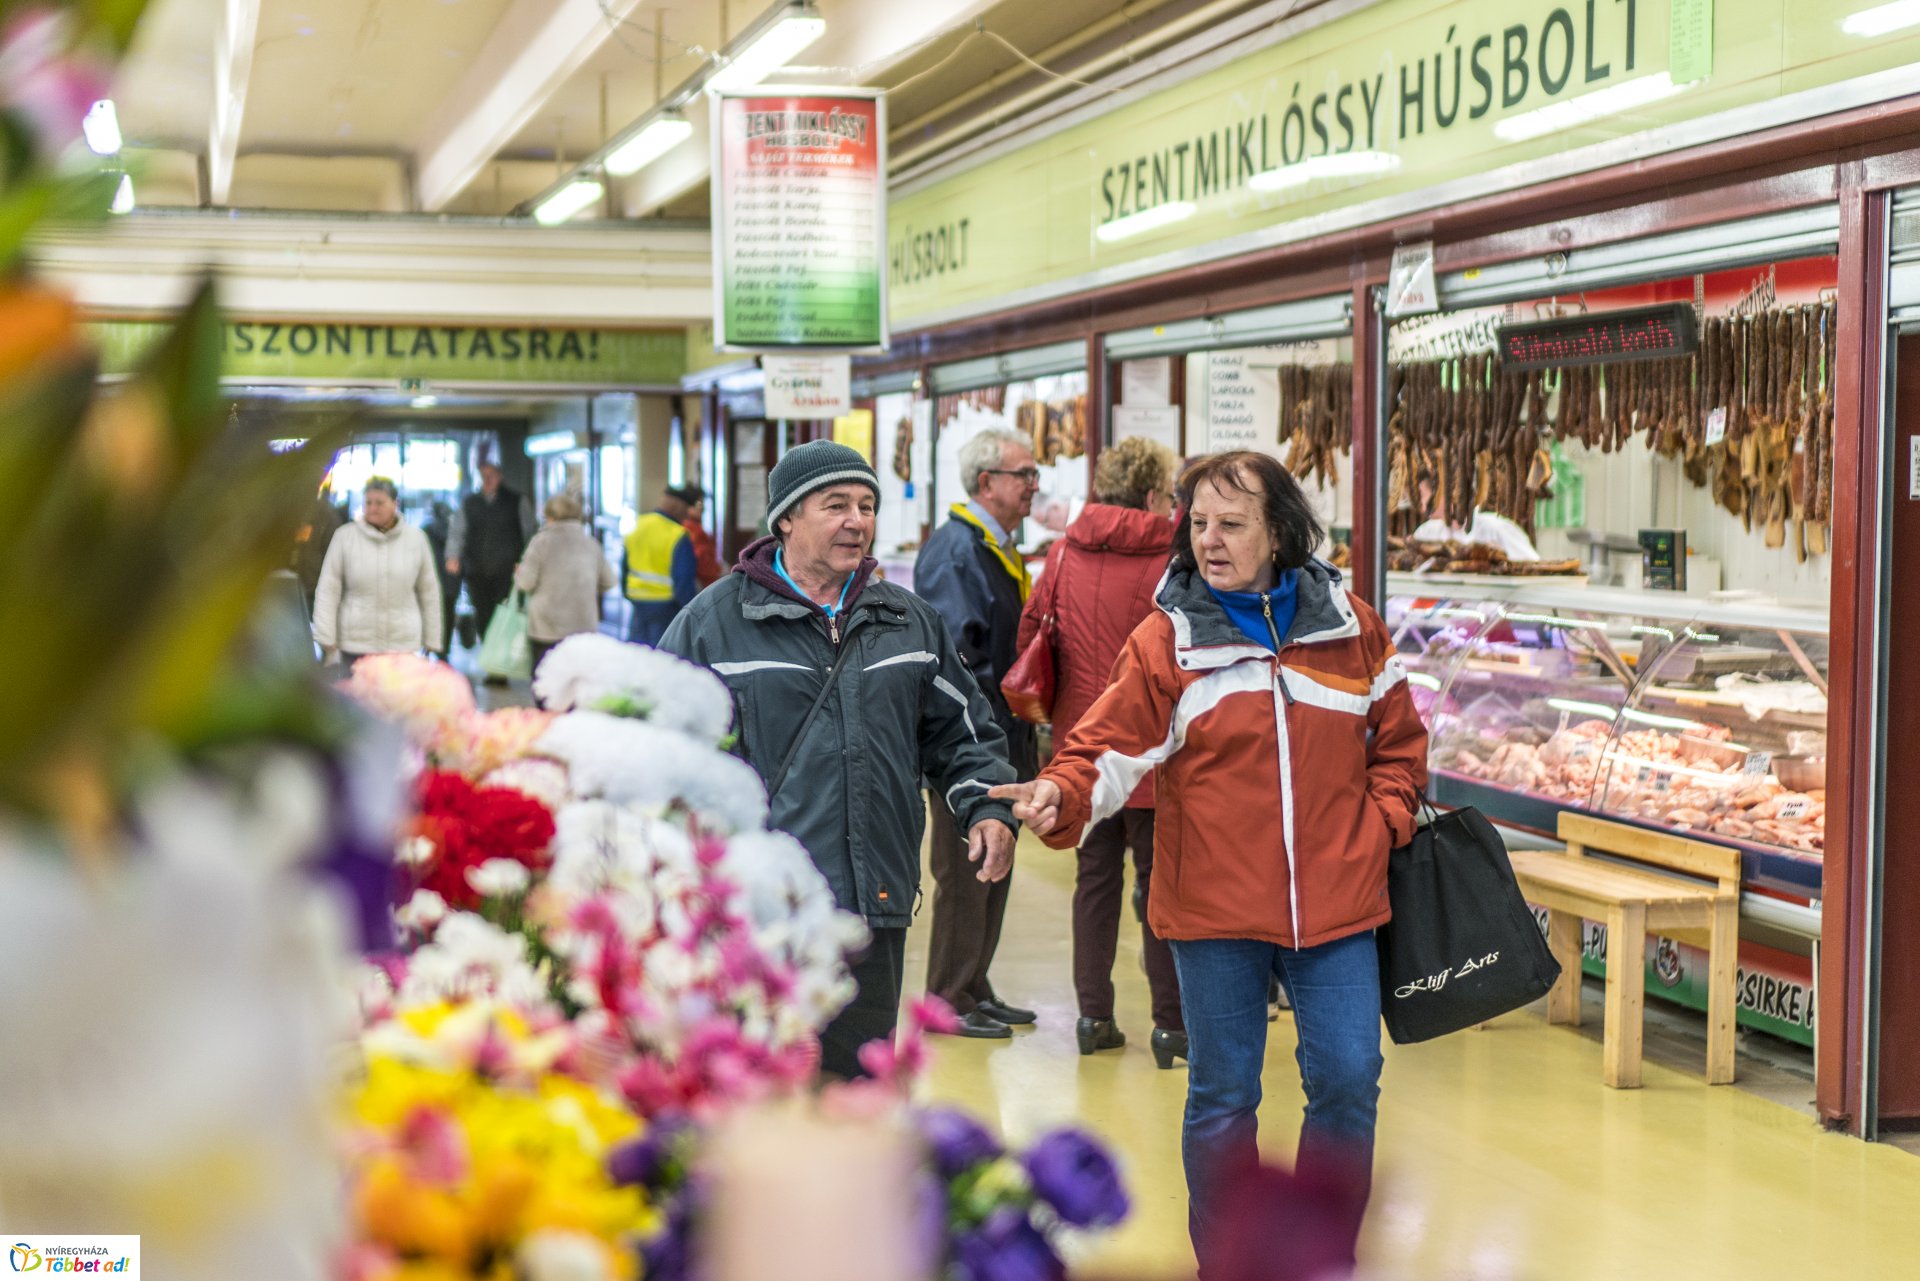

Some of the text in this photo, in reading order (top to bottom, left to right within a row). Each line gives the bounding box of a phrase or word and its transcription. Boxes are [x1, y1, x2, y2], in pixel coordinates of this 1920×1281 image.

[1101, 73, 1384, 223] SZENTMIKLÓSSY
[1399, 0, 1637, 139] HÚSBOLT
[1454, 951, 1500, 979] Arts
[1736, 967, 1802, 1023] CSIRKE
